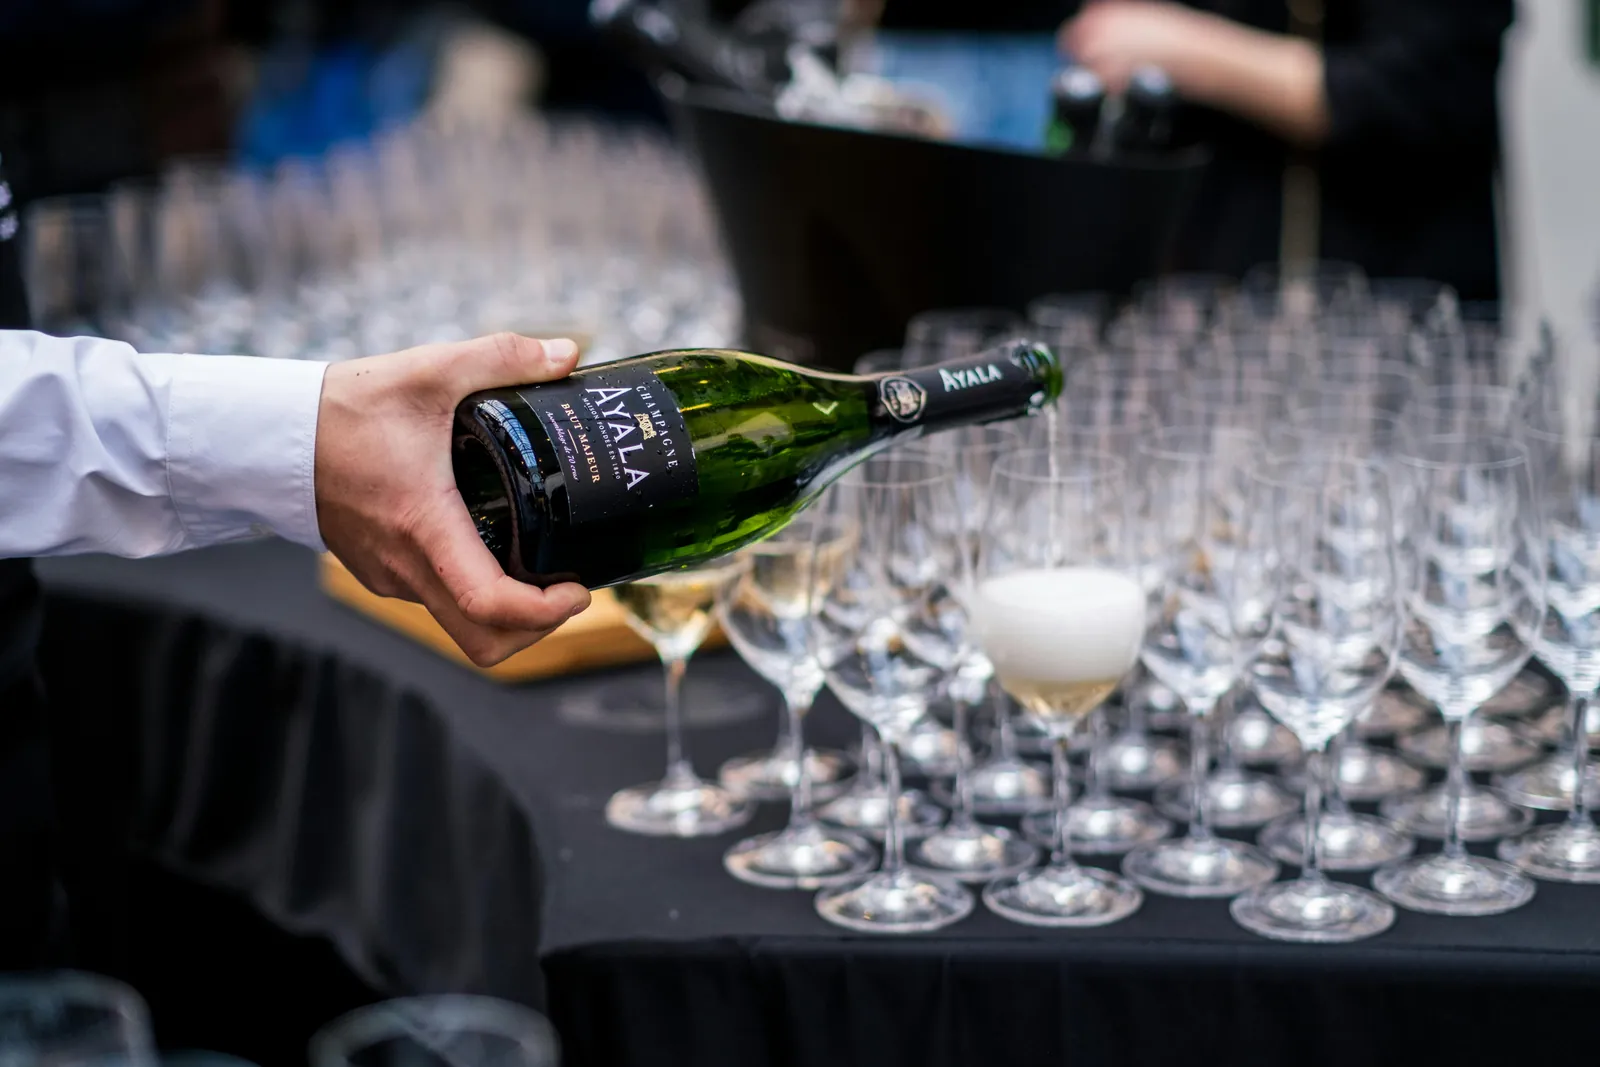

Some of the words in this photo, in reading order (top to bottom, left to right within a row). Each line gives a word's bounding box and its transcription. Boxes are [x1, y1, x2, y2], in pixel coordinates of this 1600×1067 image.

[938, 364, 1003, 392] AYALA
[561, 403, 583, 430] BRUT
[578, 433, 600, 483] MAJEUR
[564, 445, 572, 454] de
[583, 397, 600, 419] MAISON
[609, 450, 617, 460] EN
[585, 387, 650, 490] AYALA
[636, 385, 679, 468] CHAMPAGNE
